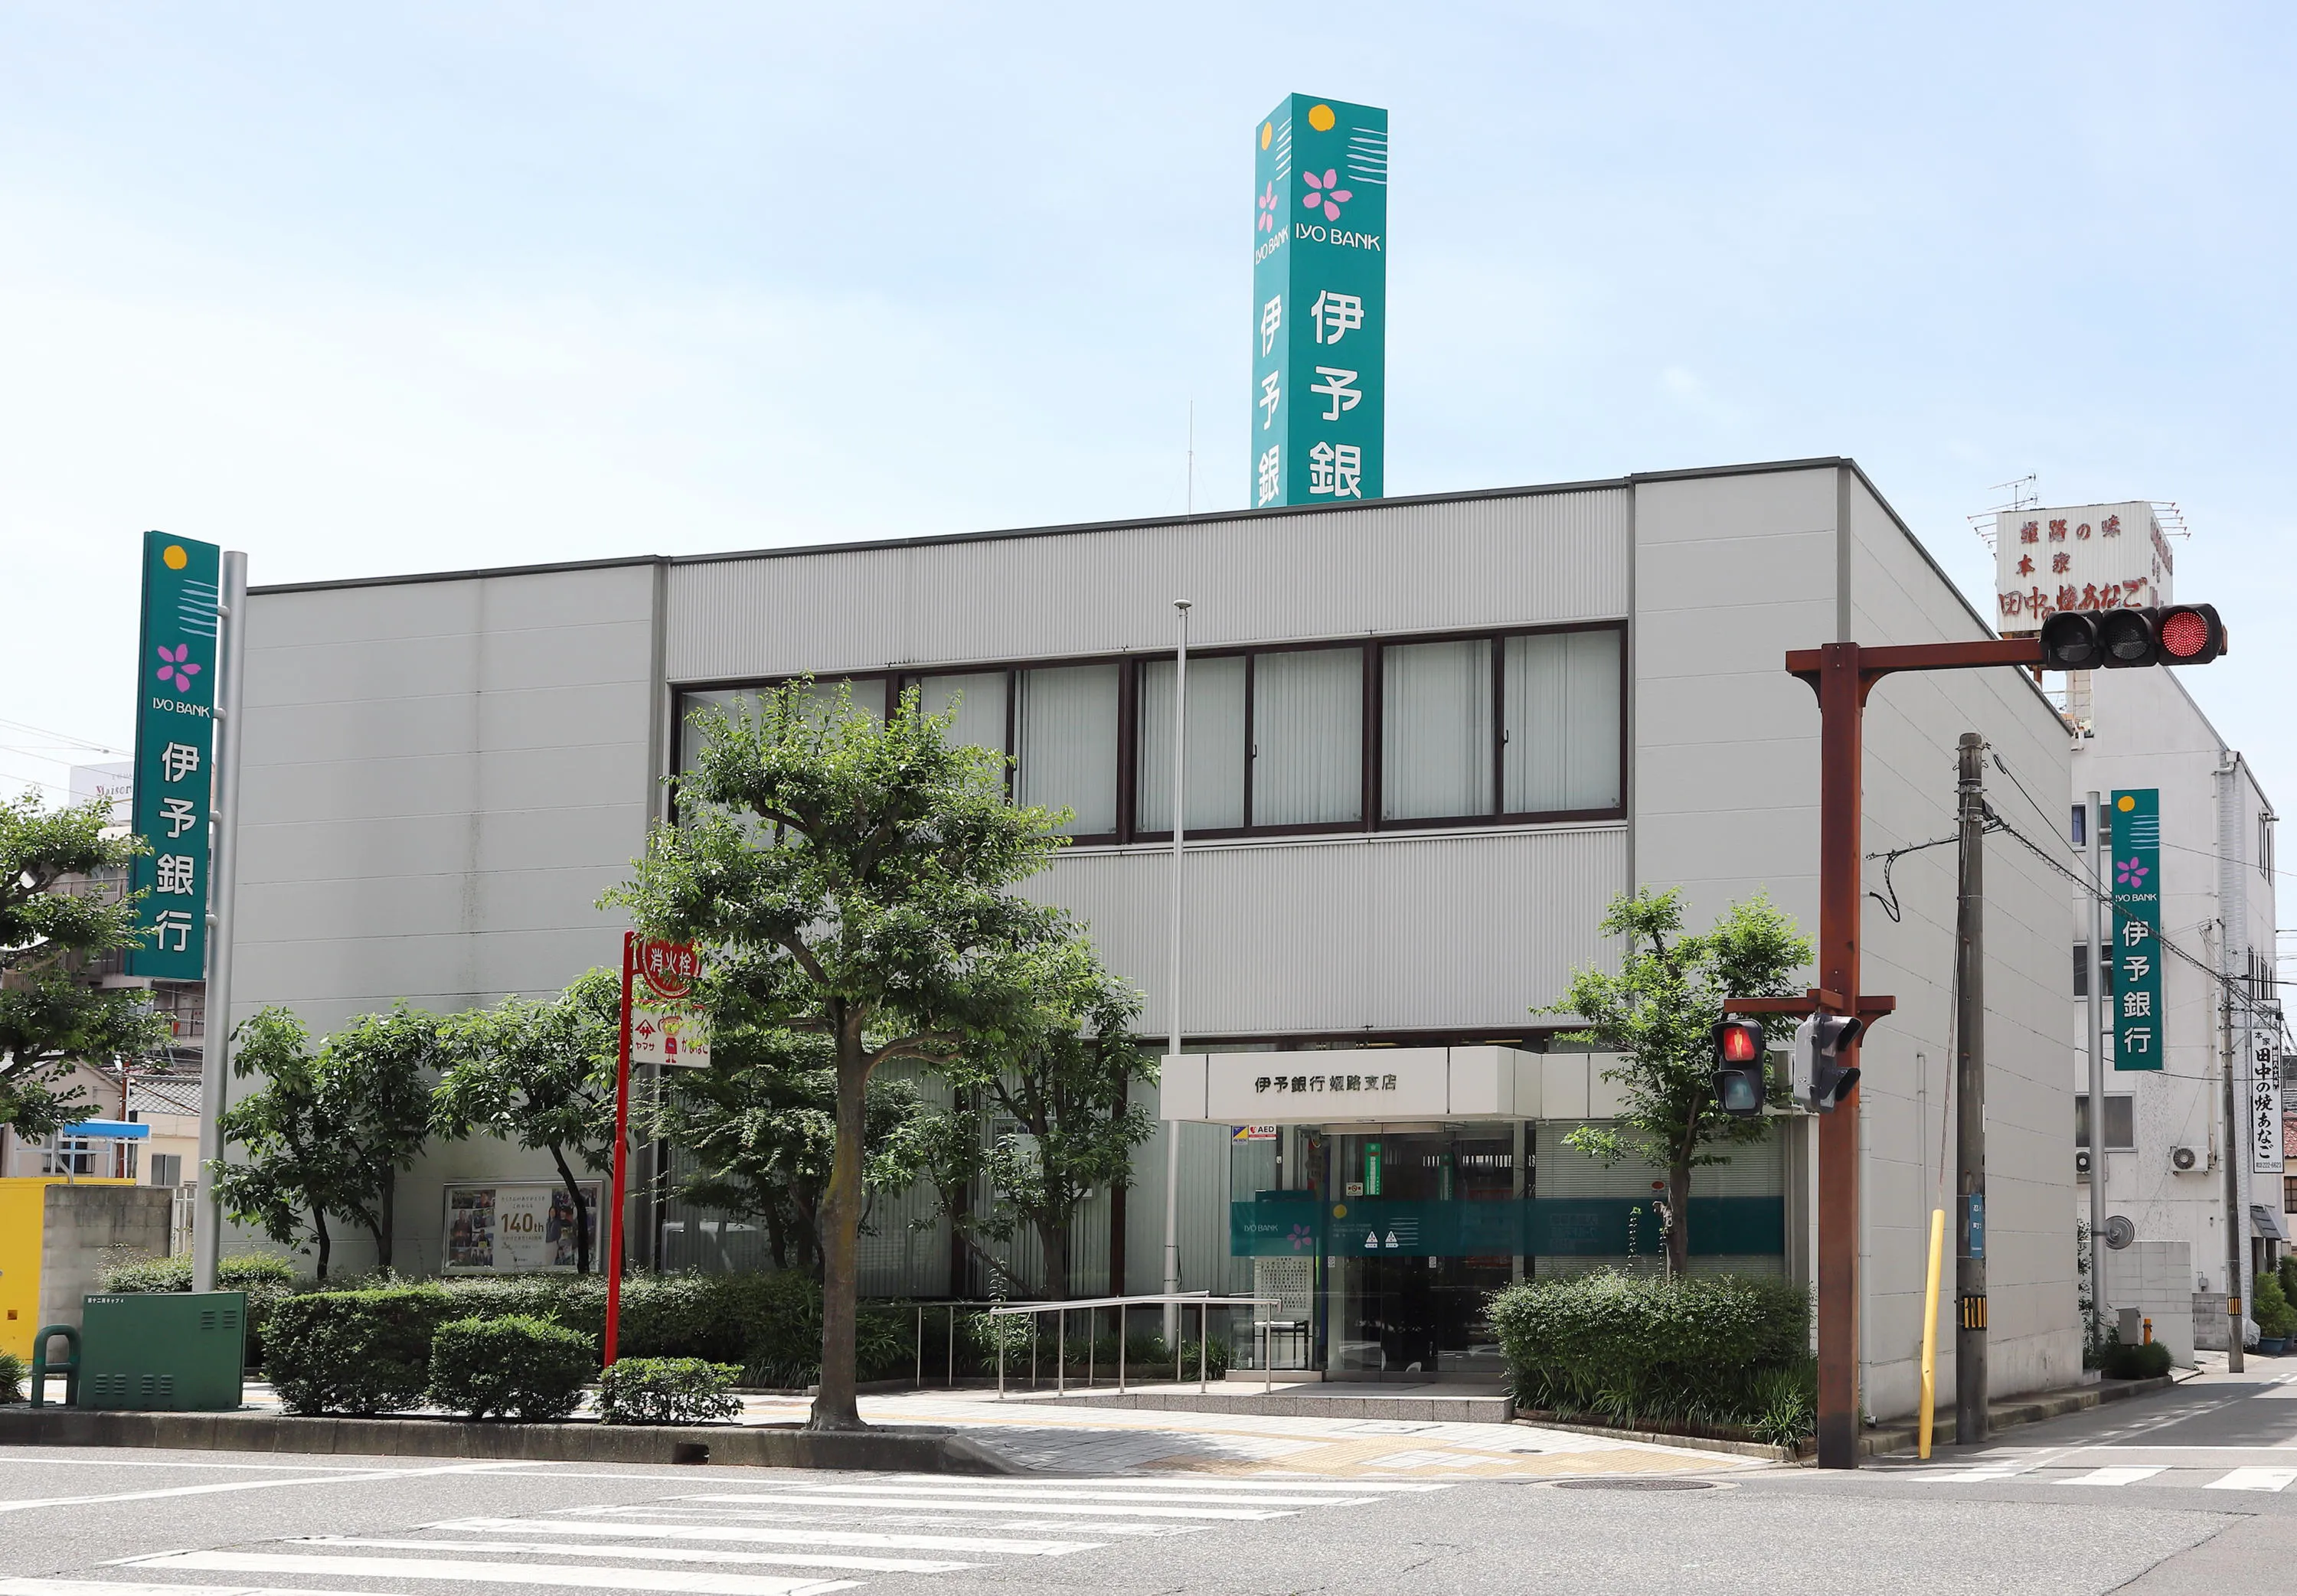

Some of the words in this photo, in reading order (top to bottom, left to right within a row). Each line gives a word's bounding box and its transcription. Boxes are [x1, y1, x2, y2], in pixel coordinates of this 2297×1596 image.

[1256, 244, 1267, 266] IYO
[1268, 224, 1289, 256] BANK
[1296, 223, 1326, 242] IYO
[1331, 229, 1381, 251] BANK
[1259, 294, 1282, 508] 伊予銀
[1310, 289, 1364, 499] 伊予銀
[153, 697, 174, 711] IYO
[176, 702, 210, 718] BANK
[155, 742, 200, 951] 伊予銀行
[2132, 893, 2157, 902] BANK
[650, 948, 691, 977] 消火栓
[2122, 921, 2151, 1053] 伊予銀行
[636, 1042, 655, 1051] ヤマサ
[2255, 1047, 2273, 1158] 田中の焼あなご
[502, 1213, 544, 1233] 140th
